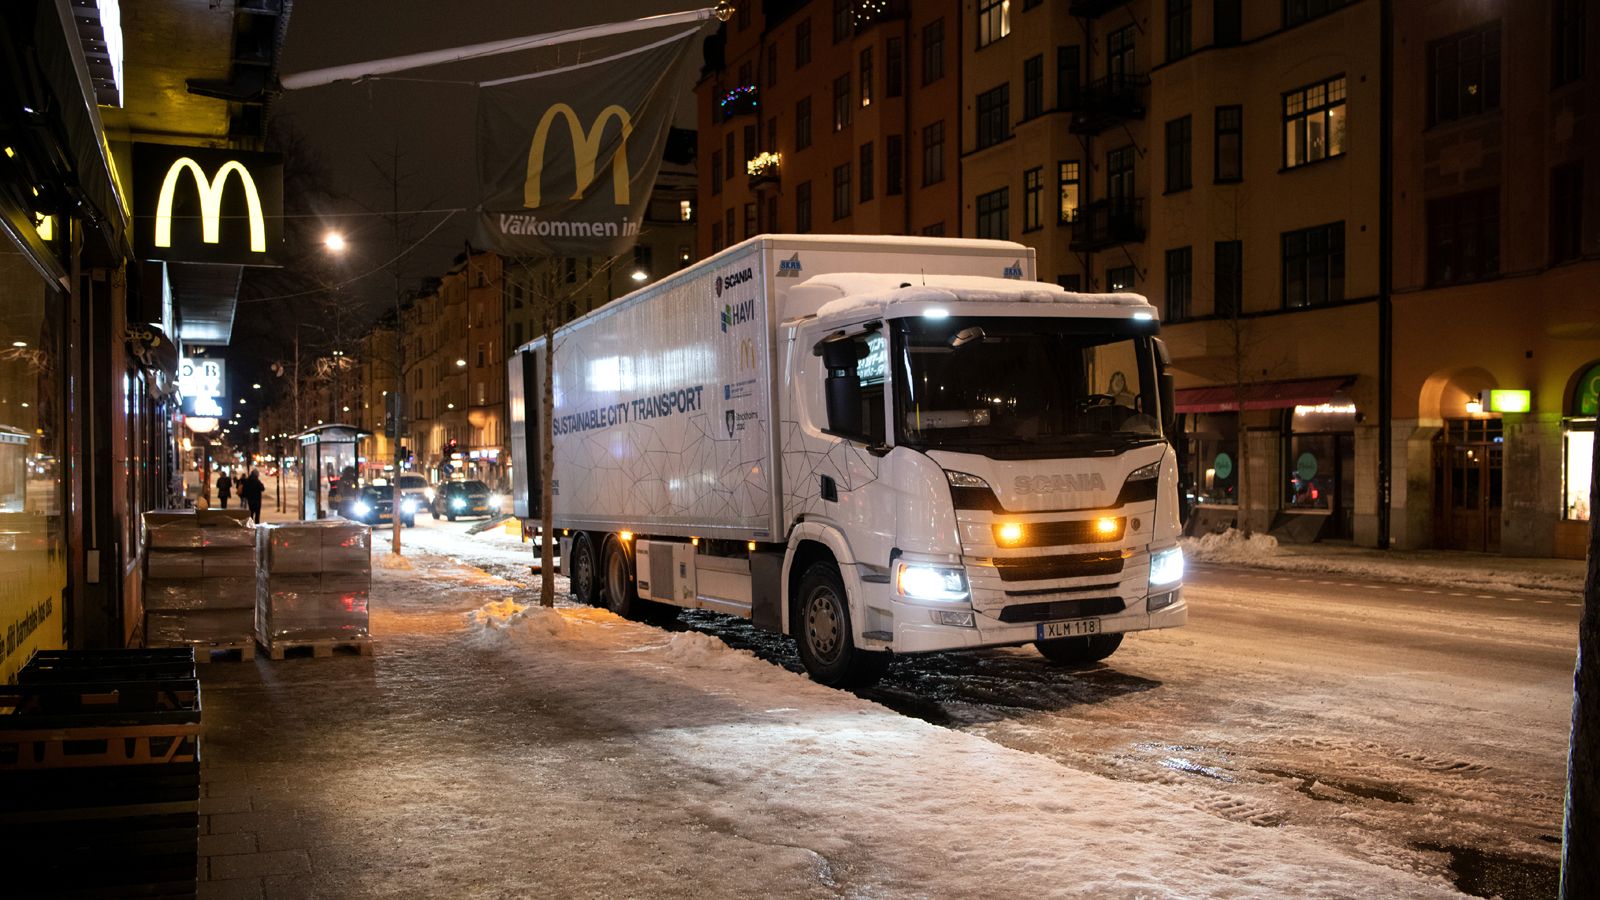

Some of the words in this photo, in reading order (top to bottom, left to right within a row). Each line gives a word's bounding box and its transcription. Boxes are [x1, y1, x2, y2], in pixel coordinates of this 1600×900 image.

[499, 213, 619, 238] Välkommen
[724, 267, 753, 290] SCANIA
[732, 299, 755, 326] HAVI
[552, 407, 607, 436] SUSTAINABLE
[607, 401, 630, 426] CITY
[631, 385, 704, 421] TRANSPORT
[1014, 472, 1106, 495] SCANIA
[1048, 623, 1071, 637] XLM
[1074, 620, 1096, 634] 118
